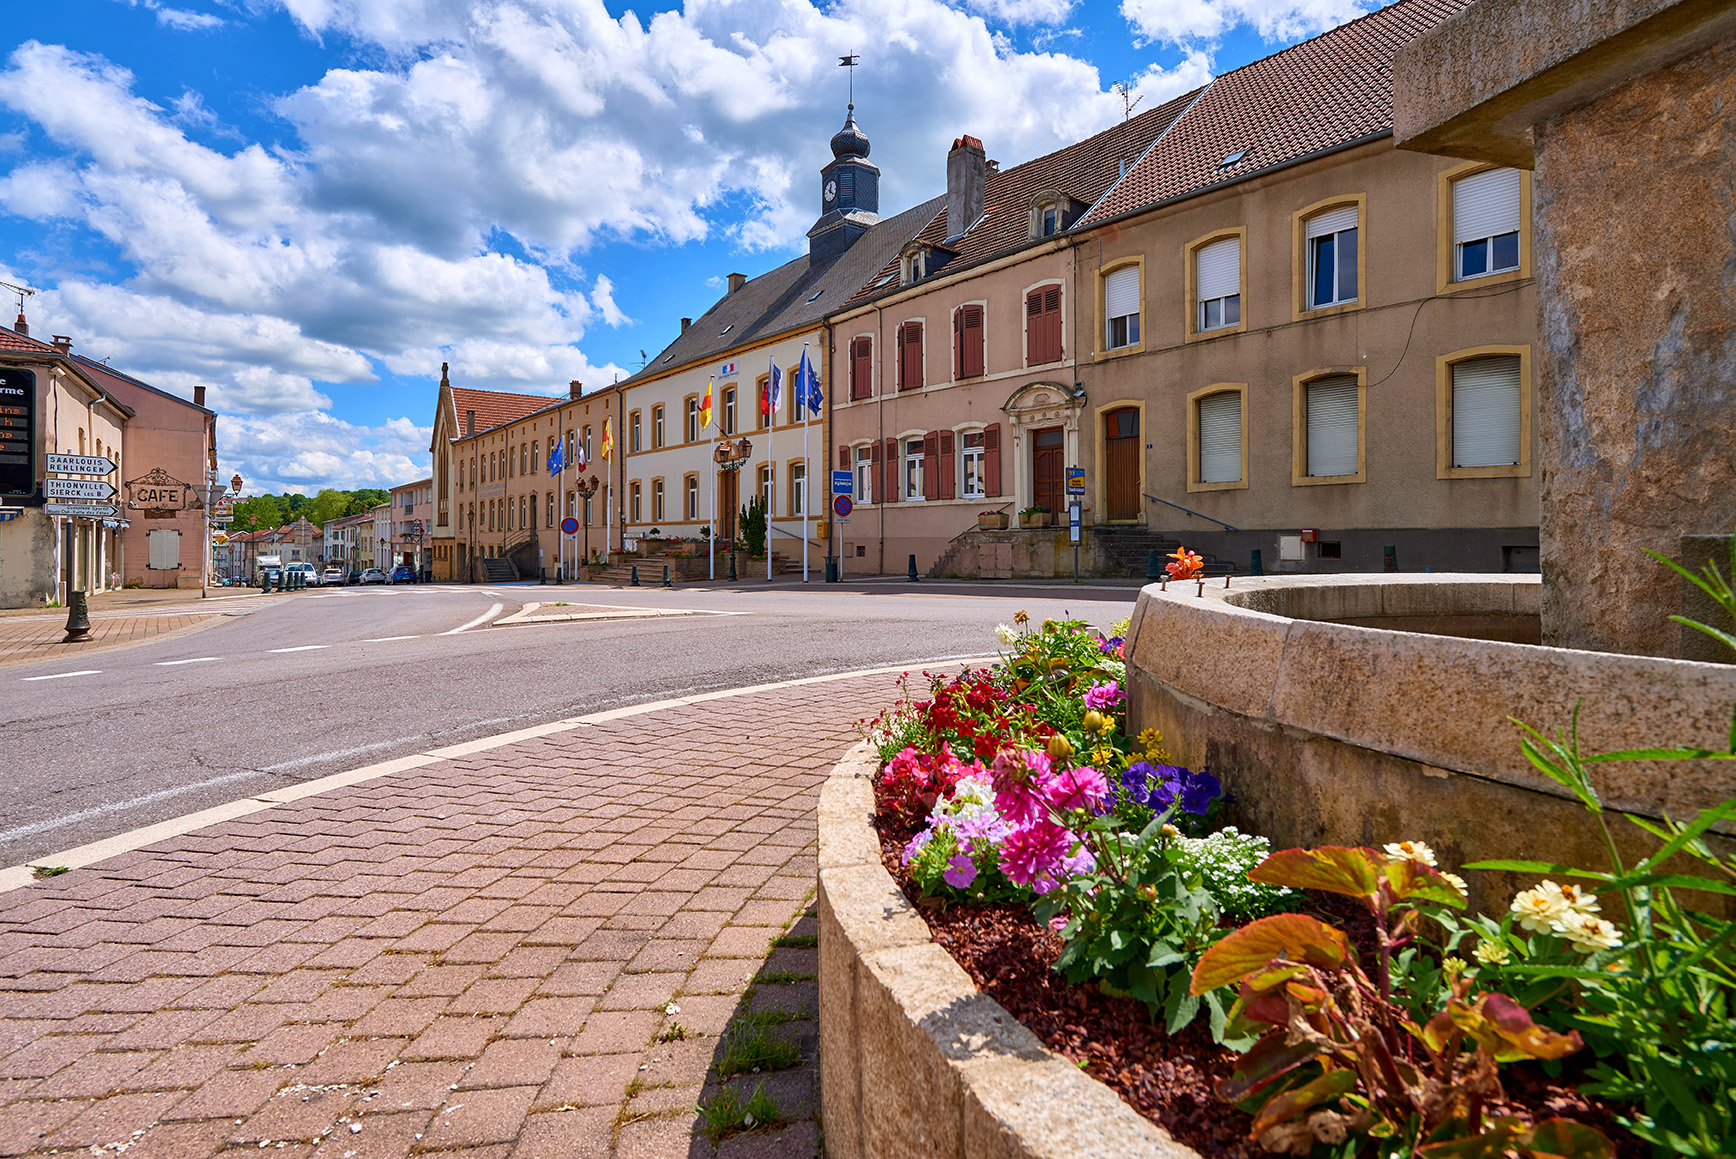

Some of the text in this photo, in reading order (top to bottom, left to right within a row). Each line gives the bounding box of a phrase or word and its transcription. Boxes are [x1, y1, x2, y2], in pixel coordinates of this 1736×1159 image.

[50, 457, 103, 465] SAARLOUIS
[50, 464, 104, 472] REHLINGEN
[50, 481, 104, 490] THIONVILLE
[137, 488, 178, 502] CAFE
